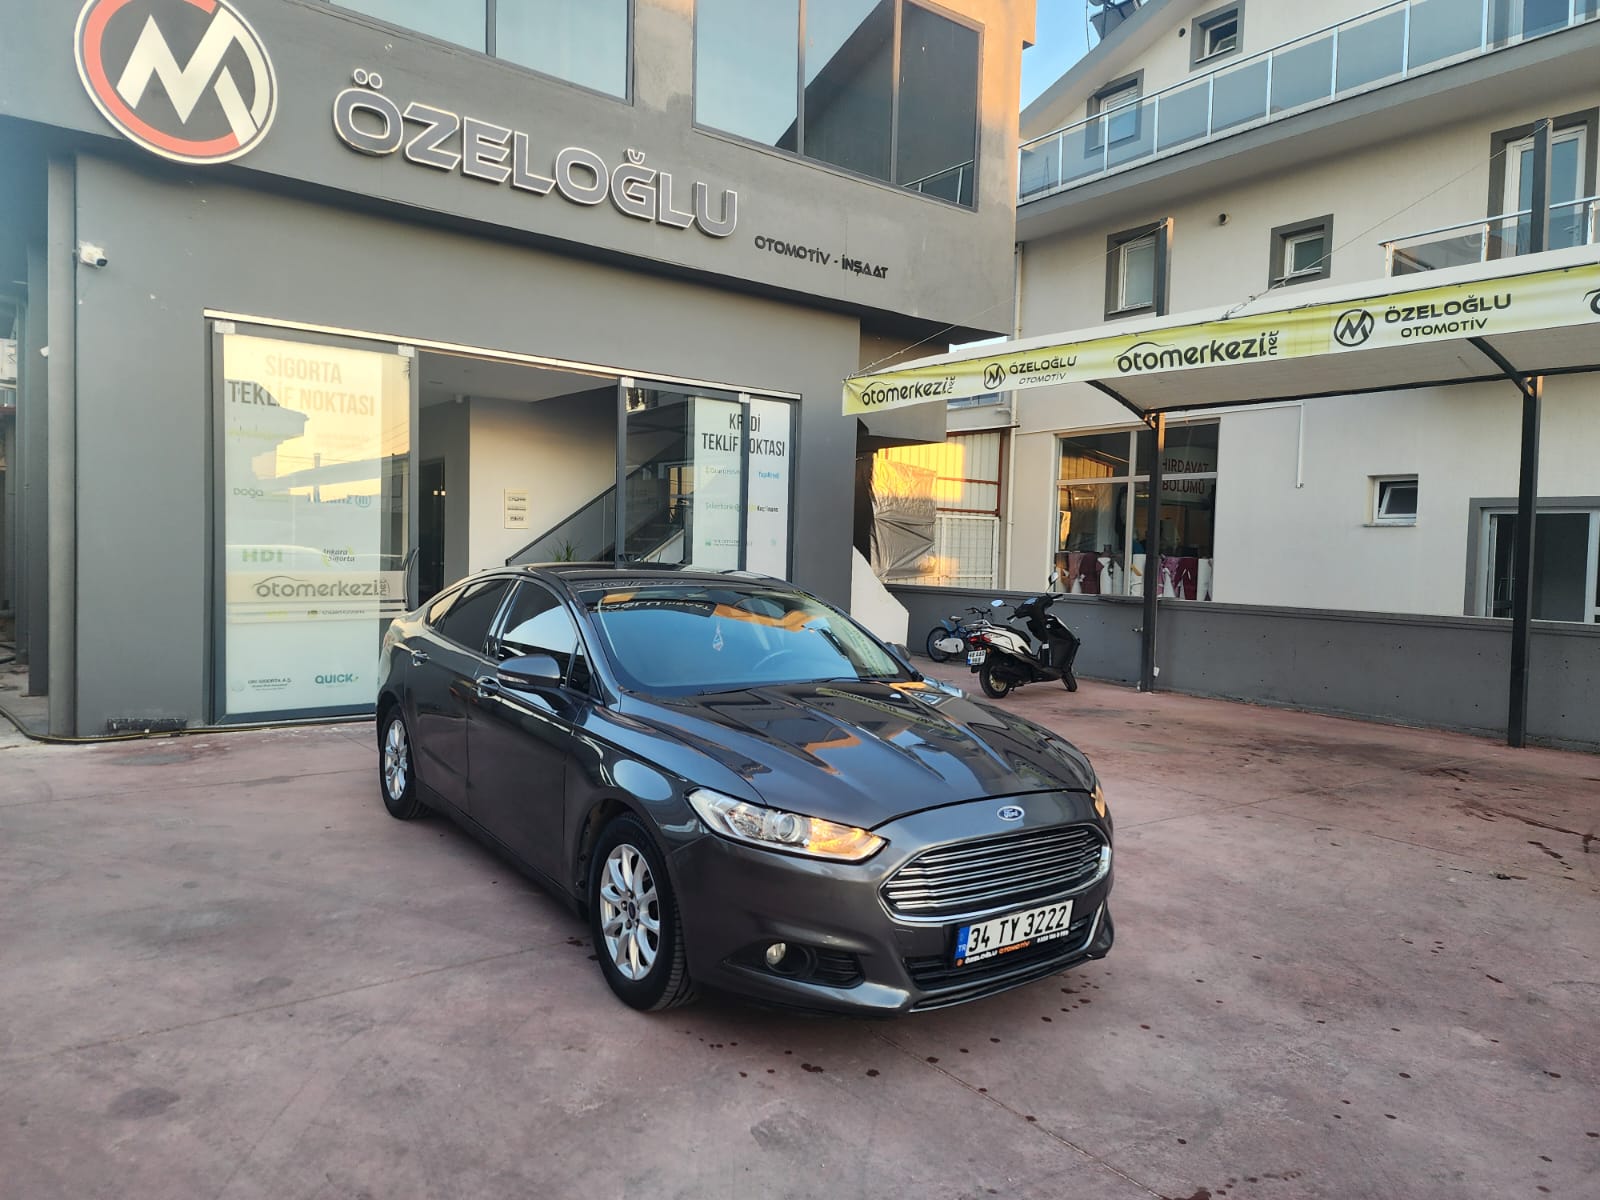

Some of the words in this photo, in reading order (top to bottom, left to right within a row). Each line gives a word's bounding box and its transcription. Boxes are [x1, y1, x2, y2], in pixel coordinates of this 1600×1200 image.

[333, 68, 738, 238] ÖZELOĞLU
[754, 235, 831, 265] OTOMOTİV
[841, 254, 889, 279] İNŞAAT
[1384, 293, 1512, 324] ÖZELOĞLU
[1400, 316, 1489, 338] OTOMOTİV
[265, 353, 342, 384] SİGORTA
[1009, 356, 1077, 375] ÖZELOĞLU
[1018, 372, 1067, 385] OTOMOTİV
[228, 380, 293, 408] TEKLİF
[300, 387, 375, 417] NOKTASI
[729, 413, 761, 433] KRDİ
[702, 433, 739, 452] TEKLİF
[748, 438, 785, 457] OKTASI
[242, 549, 283, 562] HDI
[314, 673, 353, 685] QUICK
[968, 925, 990, 953] 34
[999, 917, 1021, 944] TY
[1023, 905, 1068, 937] 3222
